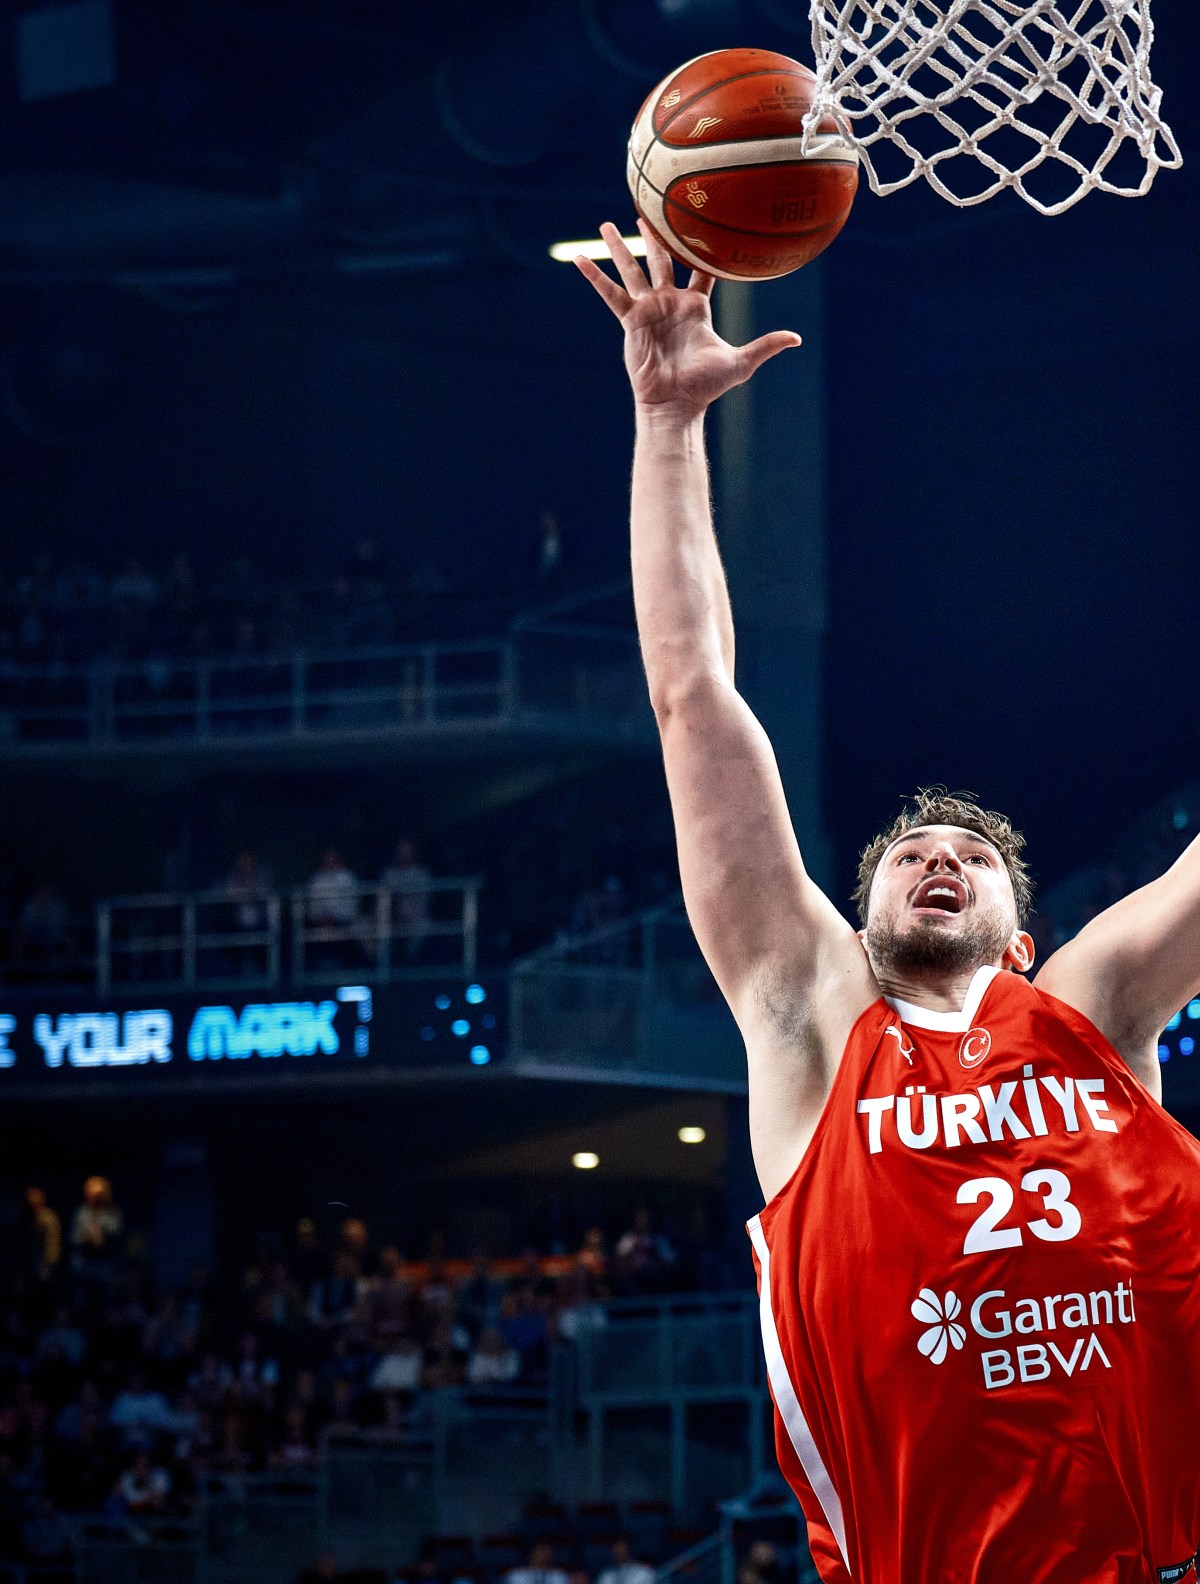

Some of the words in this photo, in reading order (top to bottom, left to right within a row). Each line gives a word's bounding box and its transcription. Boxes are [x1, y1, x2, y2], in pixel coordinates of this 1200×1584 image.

[34, 1009, 173, 1068] YOUR
[187, 1000, 340, 1061] MARK
[857, 1064, 1119, 1155] TÜRKİYE
[956, 1168, 1082, 1255] 23
[970, 1277, 1136, 1339] Garanti
[981, 1332, 1112, 1389] BBVA
